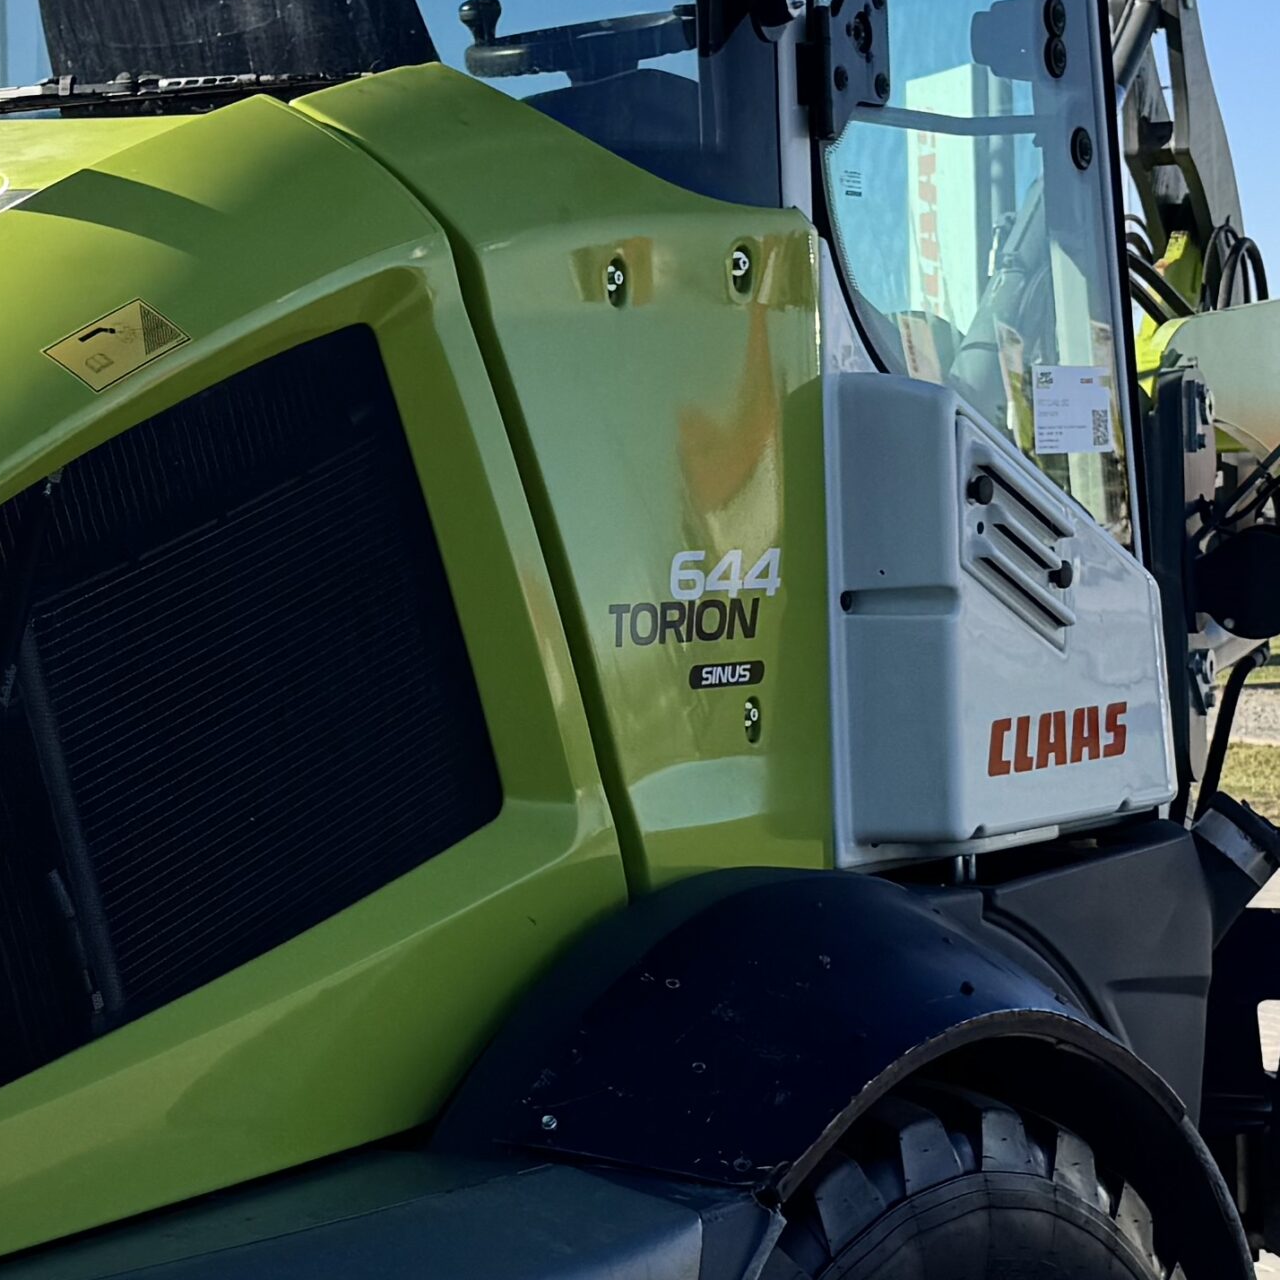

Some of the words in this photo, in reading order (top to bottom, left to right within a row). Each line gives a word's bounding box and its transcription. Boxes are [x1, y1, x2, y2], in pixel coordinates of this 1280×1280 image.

[670, 547, 782, 601] 644
[608, 597, 761, 648] TORION
[700, 664, 752, 686] SINUS
[987, 700, 1128, 778] CLAAS
